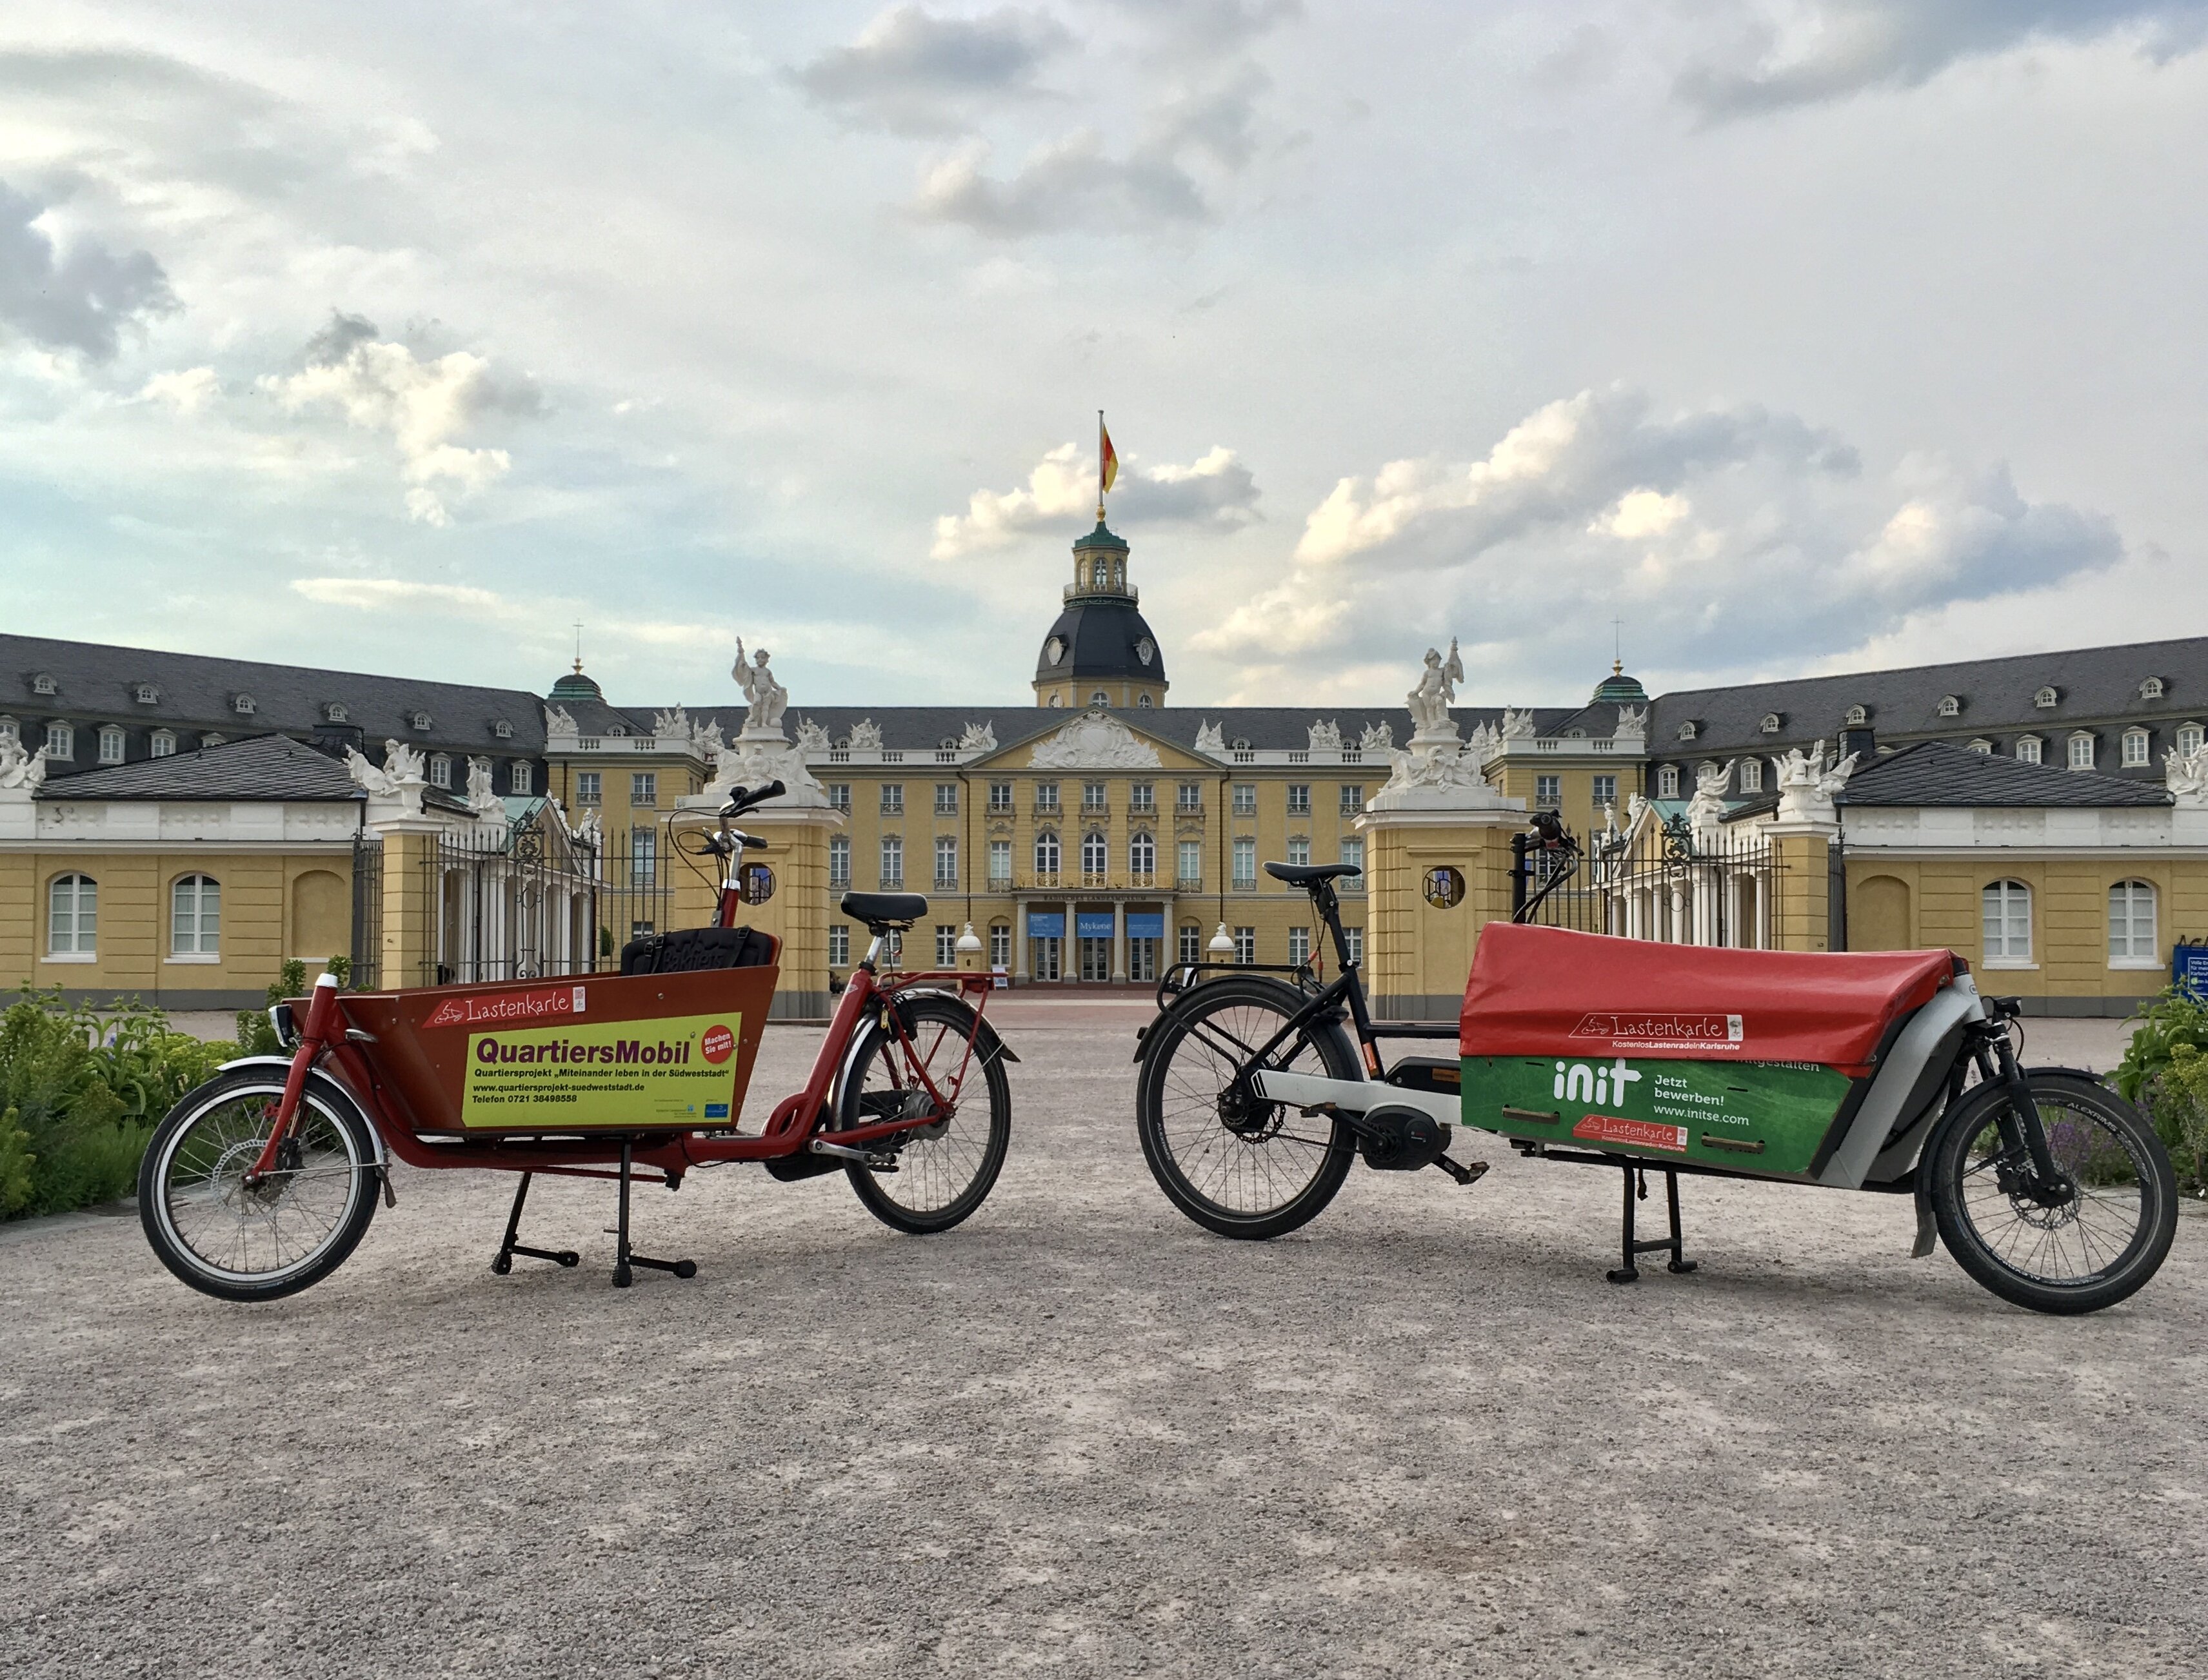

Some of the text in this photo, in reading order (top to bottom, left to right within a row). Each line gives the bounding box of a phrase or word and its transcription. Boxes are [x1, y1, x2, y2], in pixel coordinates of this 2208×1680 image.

[1080, 922, 1111, 931] Mykene
[465, 991, 569, 1021] Lastenkarle
[1611, 1016, 1722, 1038] Lastenkarle
[704, 1033, 730, 1046] Machen
[705, 1040, 731, 1054] Sie mit!
[477, 1038, 690, 1065] QuartiersMobil
[474, 1069, 552, 1078] Quartiersprojekt
[1554, 1058, 1642, 1107] init
[1655, 1074, 1687, 1089] Jetzt
[473, 1083, 644, 1093] www.quartiersprojekt-suedweststadt.de
[1654, 1087, 1724, 1106] bewerben!
[472, 1095, 505, 1103] Telefon
[533, 1094, 577, 1103] 38498558
[1654, 1105, 1749, 1126] www.initse.com
[2067, 1102, 2118, 1132] ALEXRIMS
[1602, 1118, 1675, 1141] Lastenkarle
